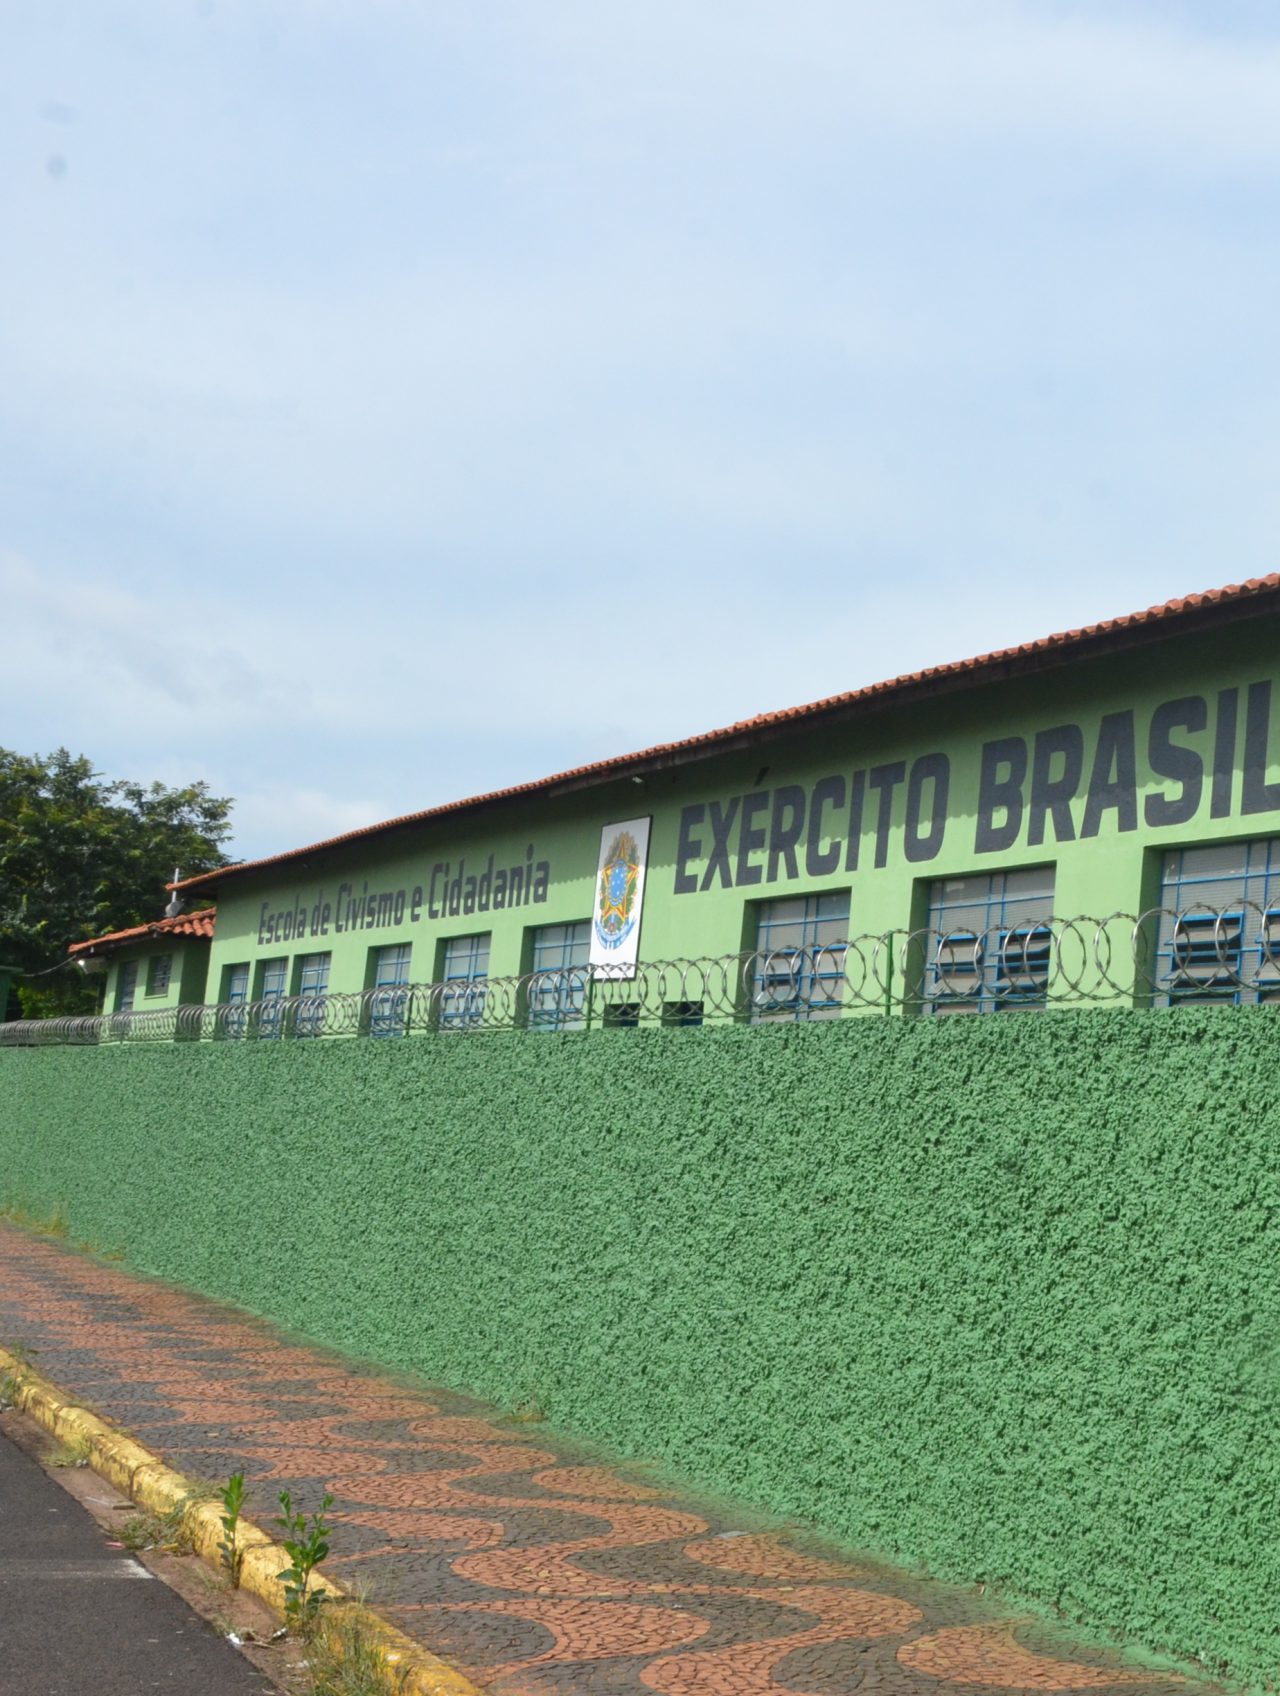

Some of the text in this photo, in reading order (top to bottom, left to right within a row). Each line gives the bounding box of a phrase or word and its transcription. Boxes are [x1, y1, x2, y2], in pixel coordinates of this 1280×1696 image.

[674, 752, 950, 895] EXÉRCITO
[257, 843, 550, 945] Escola de Civismo e Cidadania
